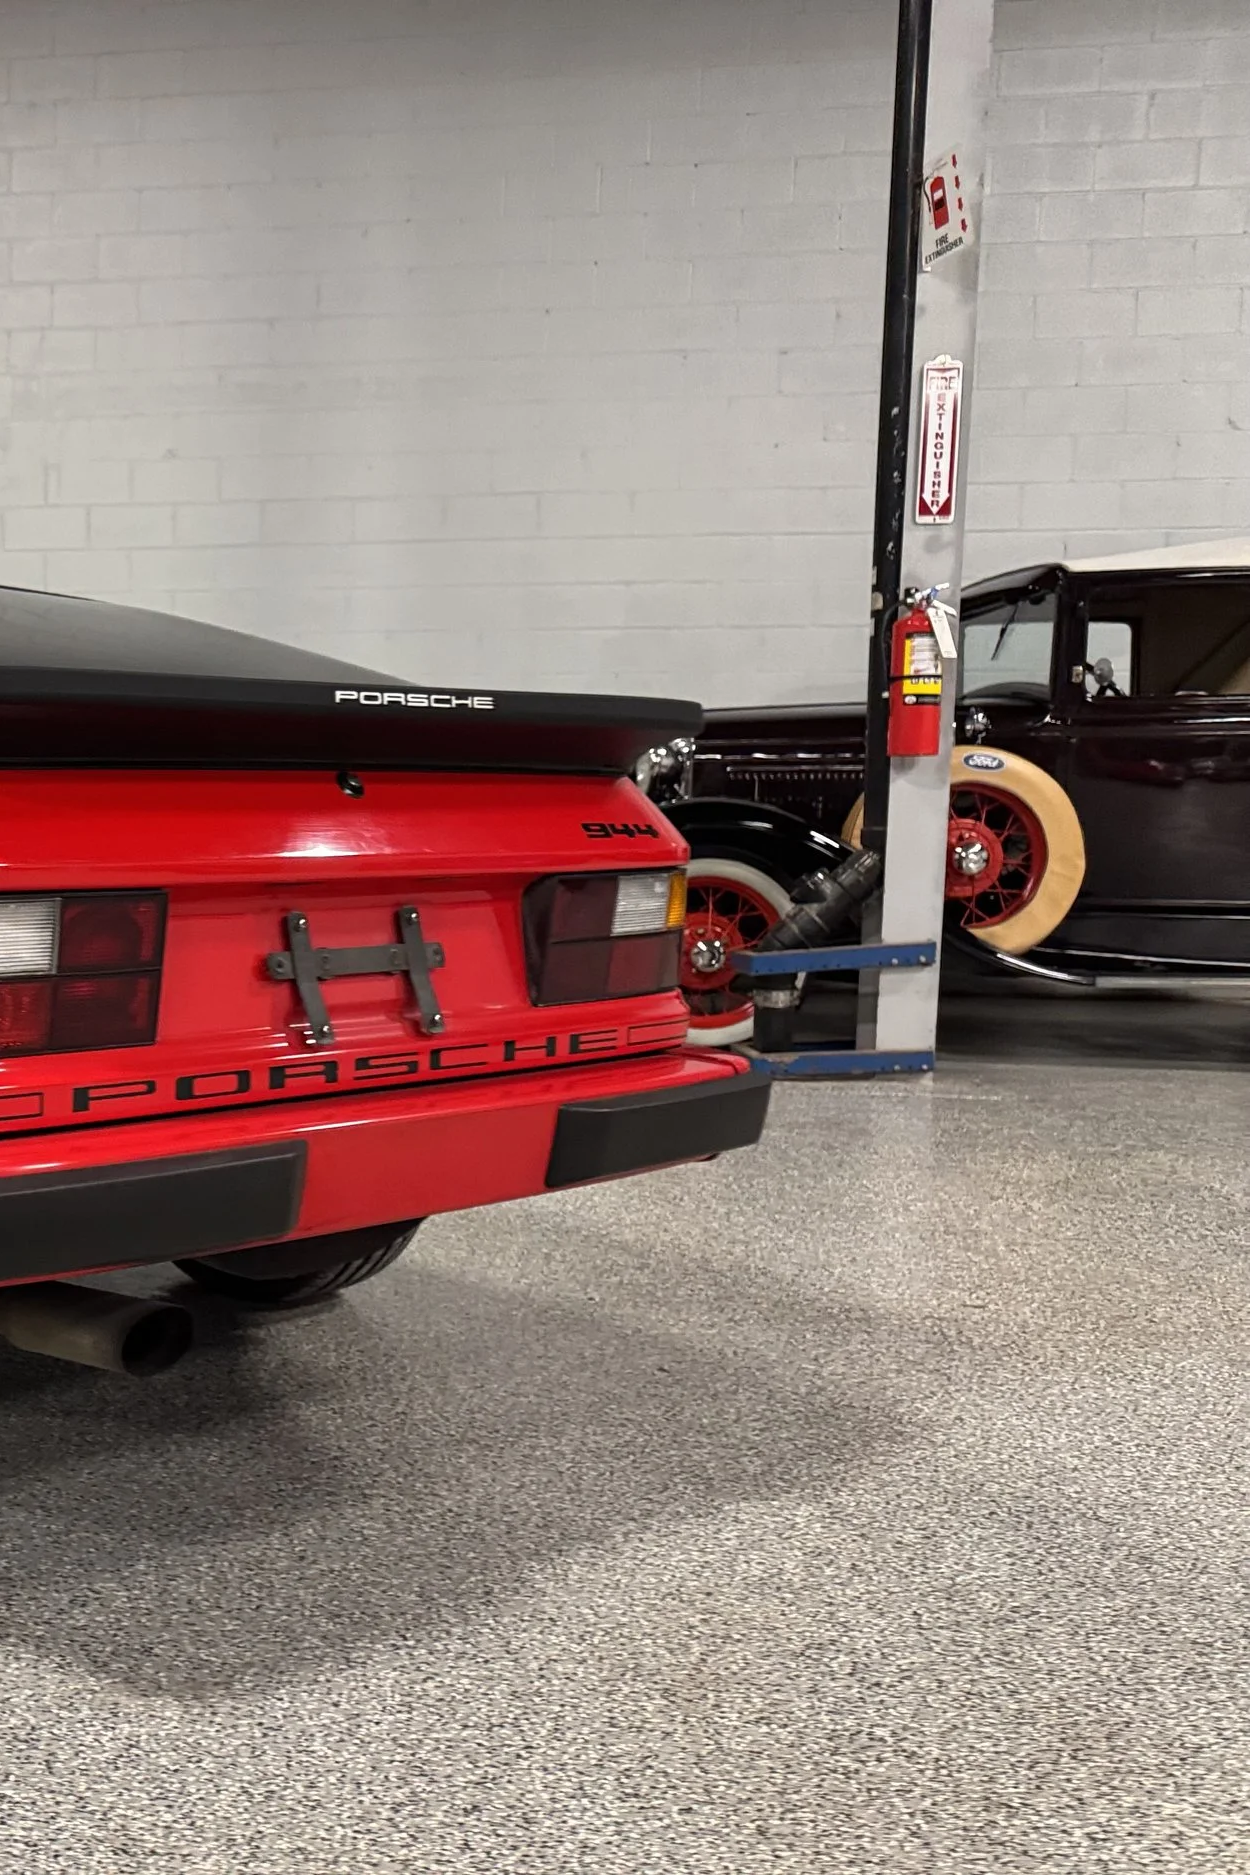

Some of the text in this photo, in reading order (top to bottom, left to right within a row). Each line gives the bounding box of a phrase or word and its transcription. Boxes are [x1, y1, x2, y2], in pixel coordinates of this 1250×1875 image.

[925, 236, 964, 265] EXTINGUISHER
[935, 233, 949, 249] FIRE
[930, 392, 946, 508] EXTINGUISHER
[334, 690, 495, 710] PORSCHE
[580, 822, 660, 839] 944
[72, 1029, 619, 1113] PORSCHE
